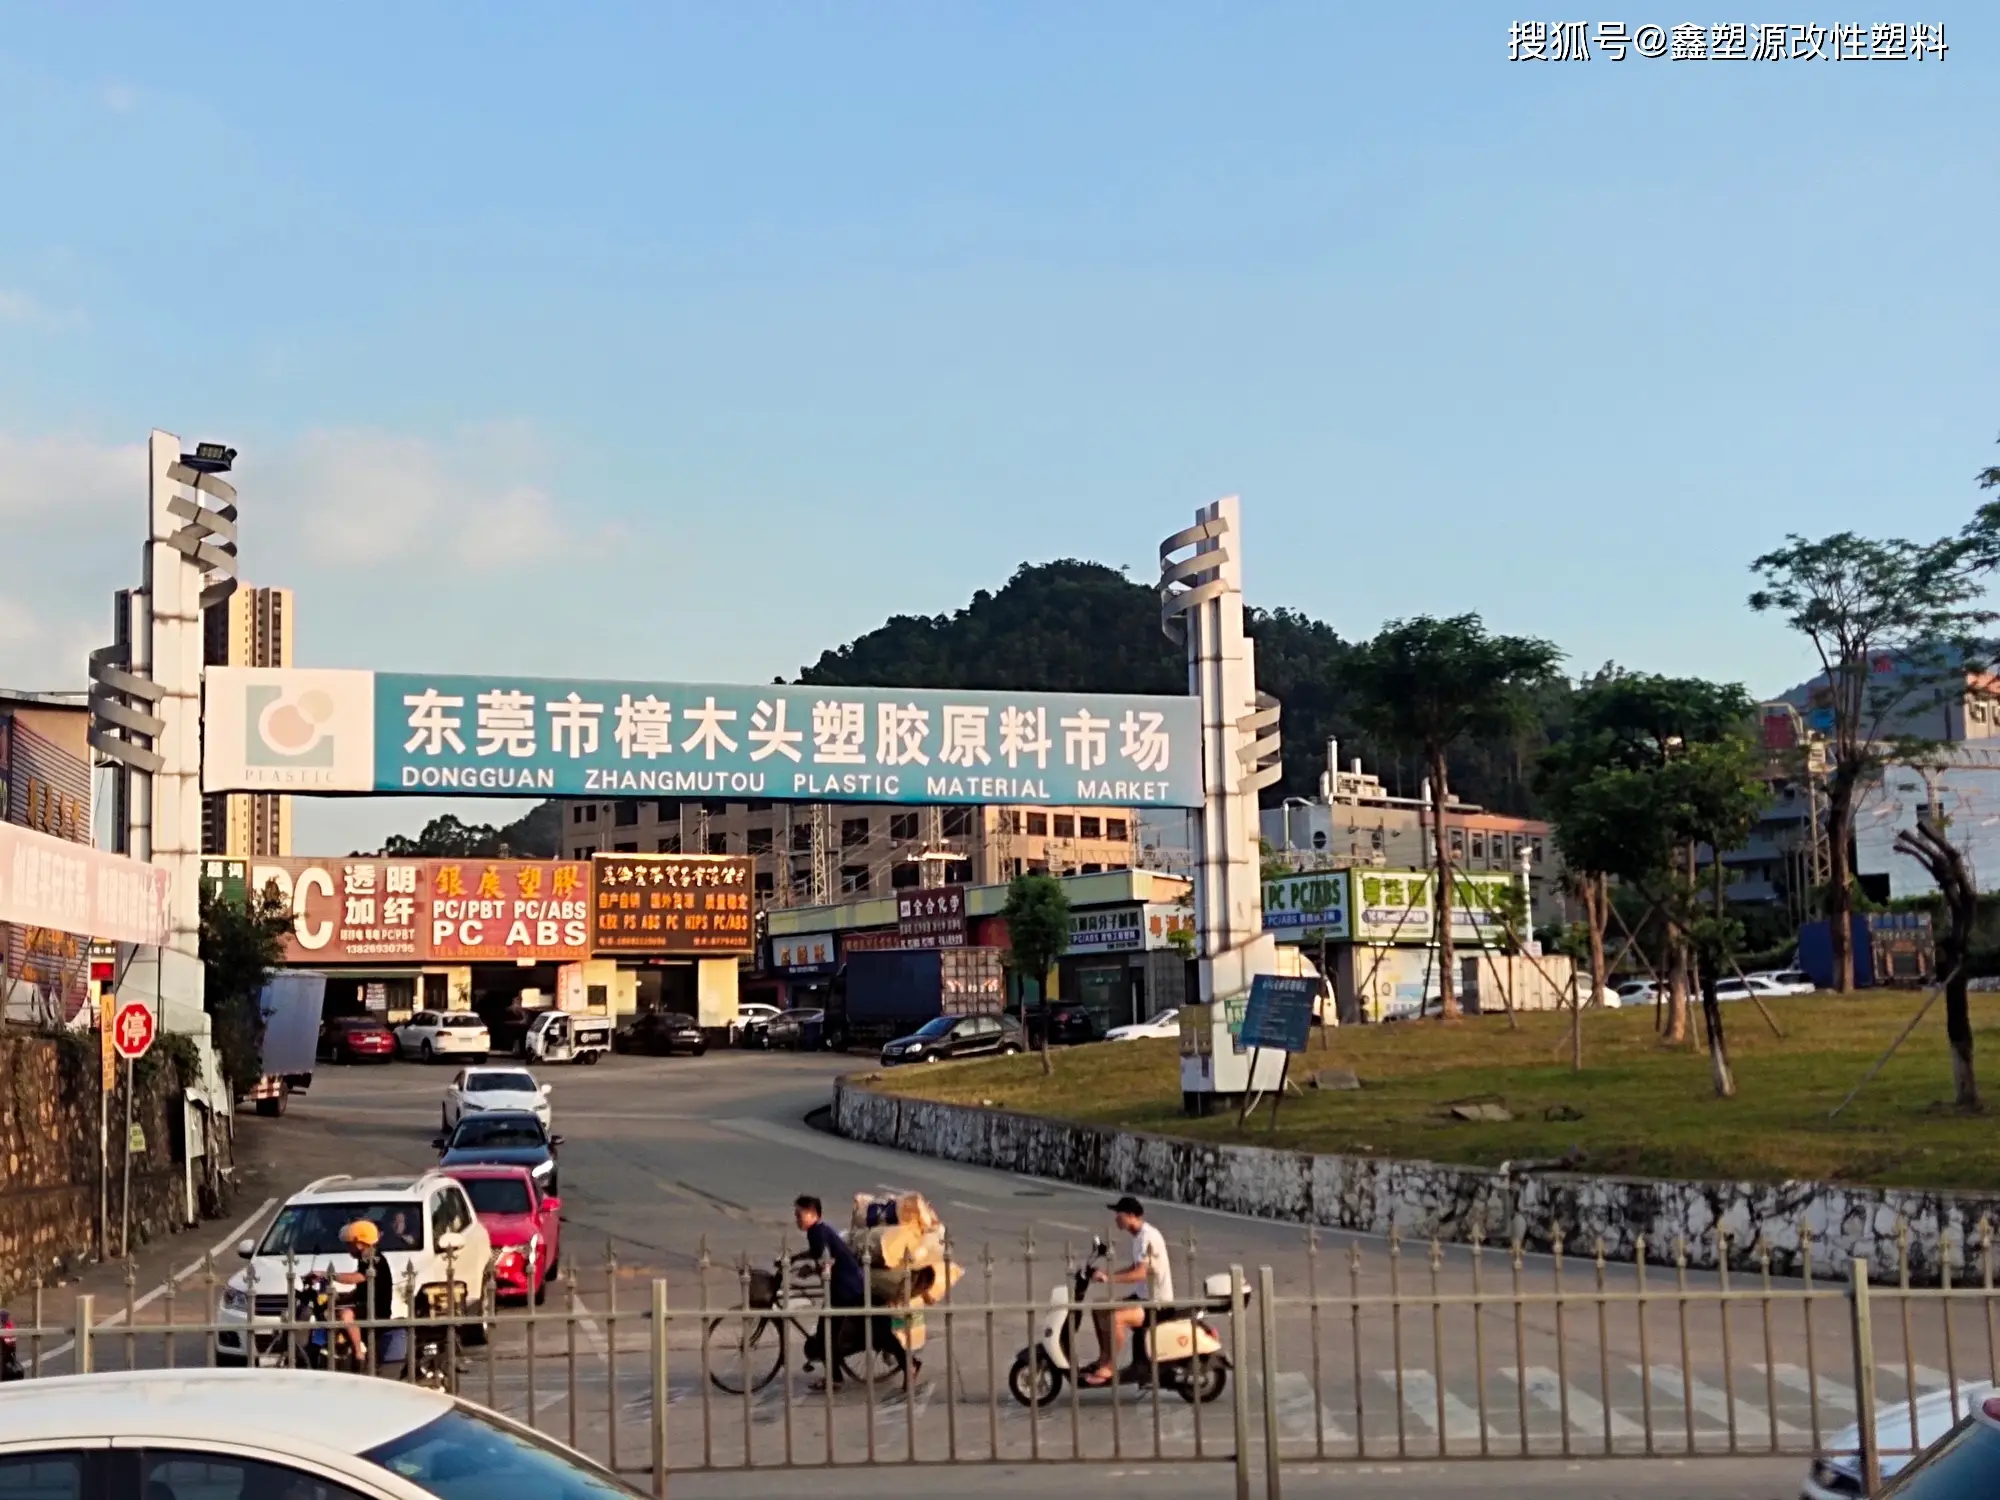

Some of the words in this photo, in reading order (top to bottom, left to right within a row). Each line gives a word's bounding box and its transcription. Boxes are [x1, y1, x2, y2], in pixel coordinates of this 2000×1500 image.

[402, 688, 1171, 773] 东莞市樟木头塑胶原料市场
[244, 769, 335, 784] PLASTIC
[402, 766, 555, 790] DONGGUAN
[584, 769, 766, 795] ZHANGMUTOU
[793, 773, 900, 796] PLASTIC
[926, 776, 1051, 799] MATERIAL
[1077, 780, 1170, 801] MARKET
[344, 863, 416, 895] 透明
[1268, 883, 1286, 911] PC
[1290, 878, 1341, 910] PC/ABS
[252, 866, 335, 950] PC
[343, 897, 415, 926] 加纤
[432, 900, 505, 920] PC/PBT
[513, 900, 587, 921] PC/ABS
[623, 914, 637, 930] PS
[641, 914, 660, 930] ABS
[666, 914, 679, 930] PC
[713, 914, 748, 931] PC/ABS
[432, 920, 484, 946] PC
[505, 920, 587, 946] ABS
[121, 1011, 147, 1048] 停
